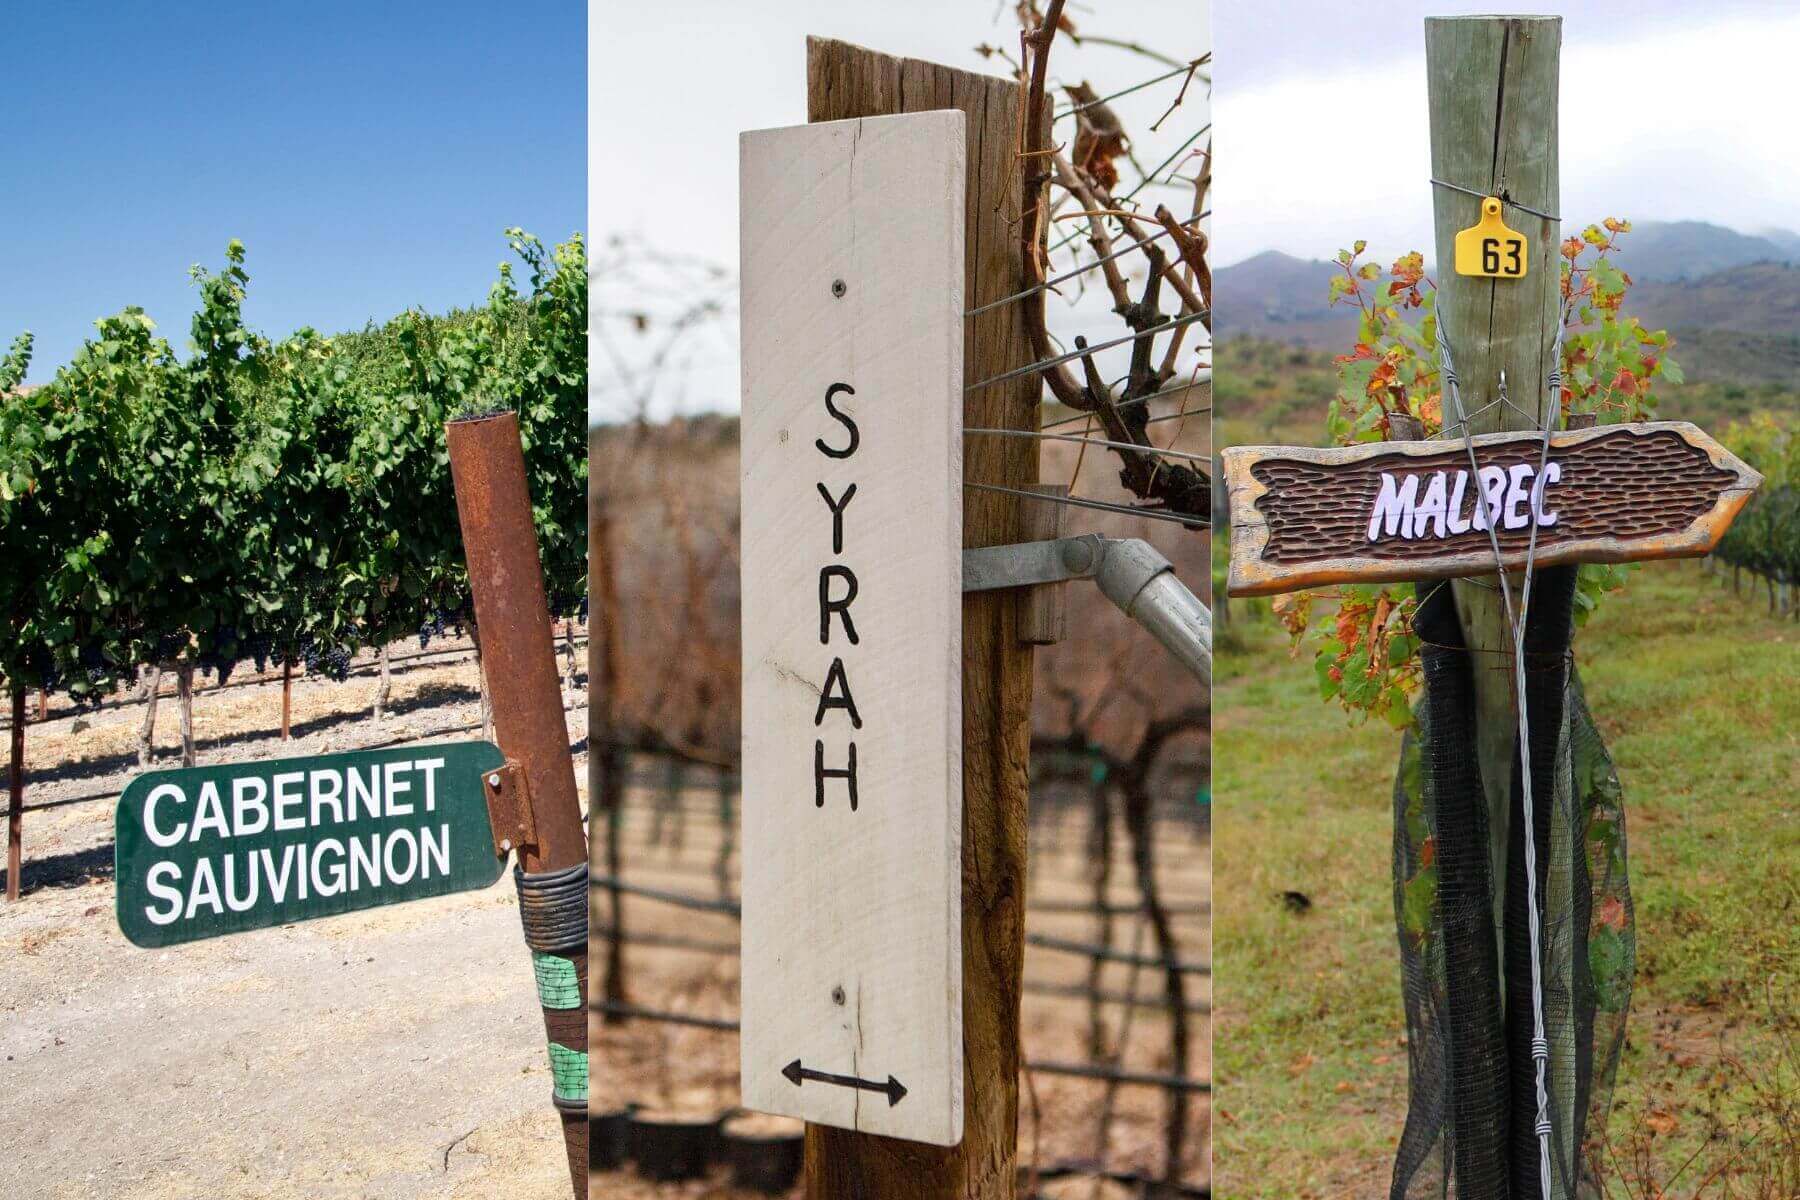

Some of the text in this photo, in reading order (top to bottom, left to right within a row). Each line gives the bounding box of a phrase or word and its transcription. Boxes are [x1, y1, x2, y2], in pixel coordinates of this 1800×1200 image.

[1483, 238, 1521, 275] 63
[1367, 462, 1561, 541] MALBEC
[815, 383, 862, 811] SYRAH
[143, 758, 444, 847] CABERNET
[145, 824, 450, 925] SAUVIGNON
